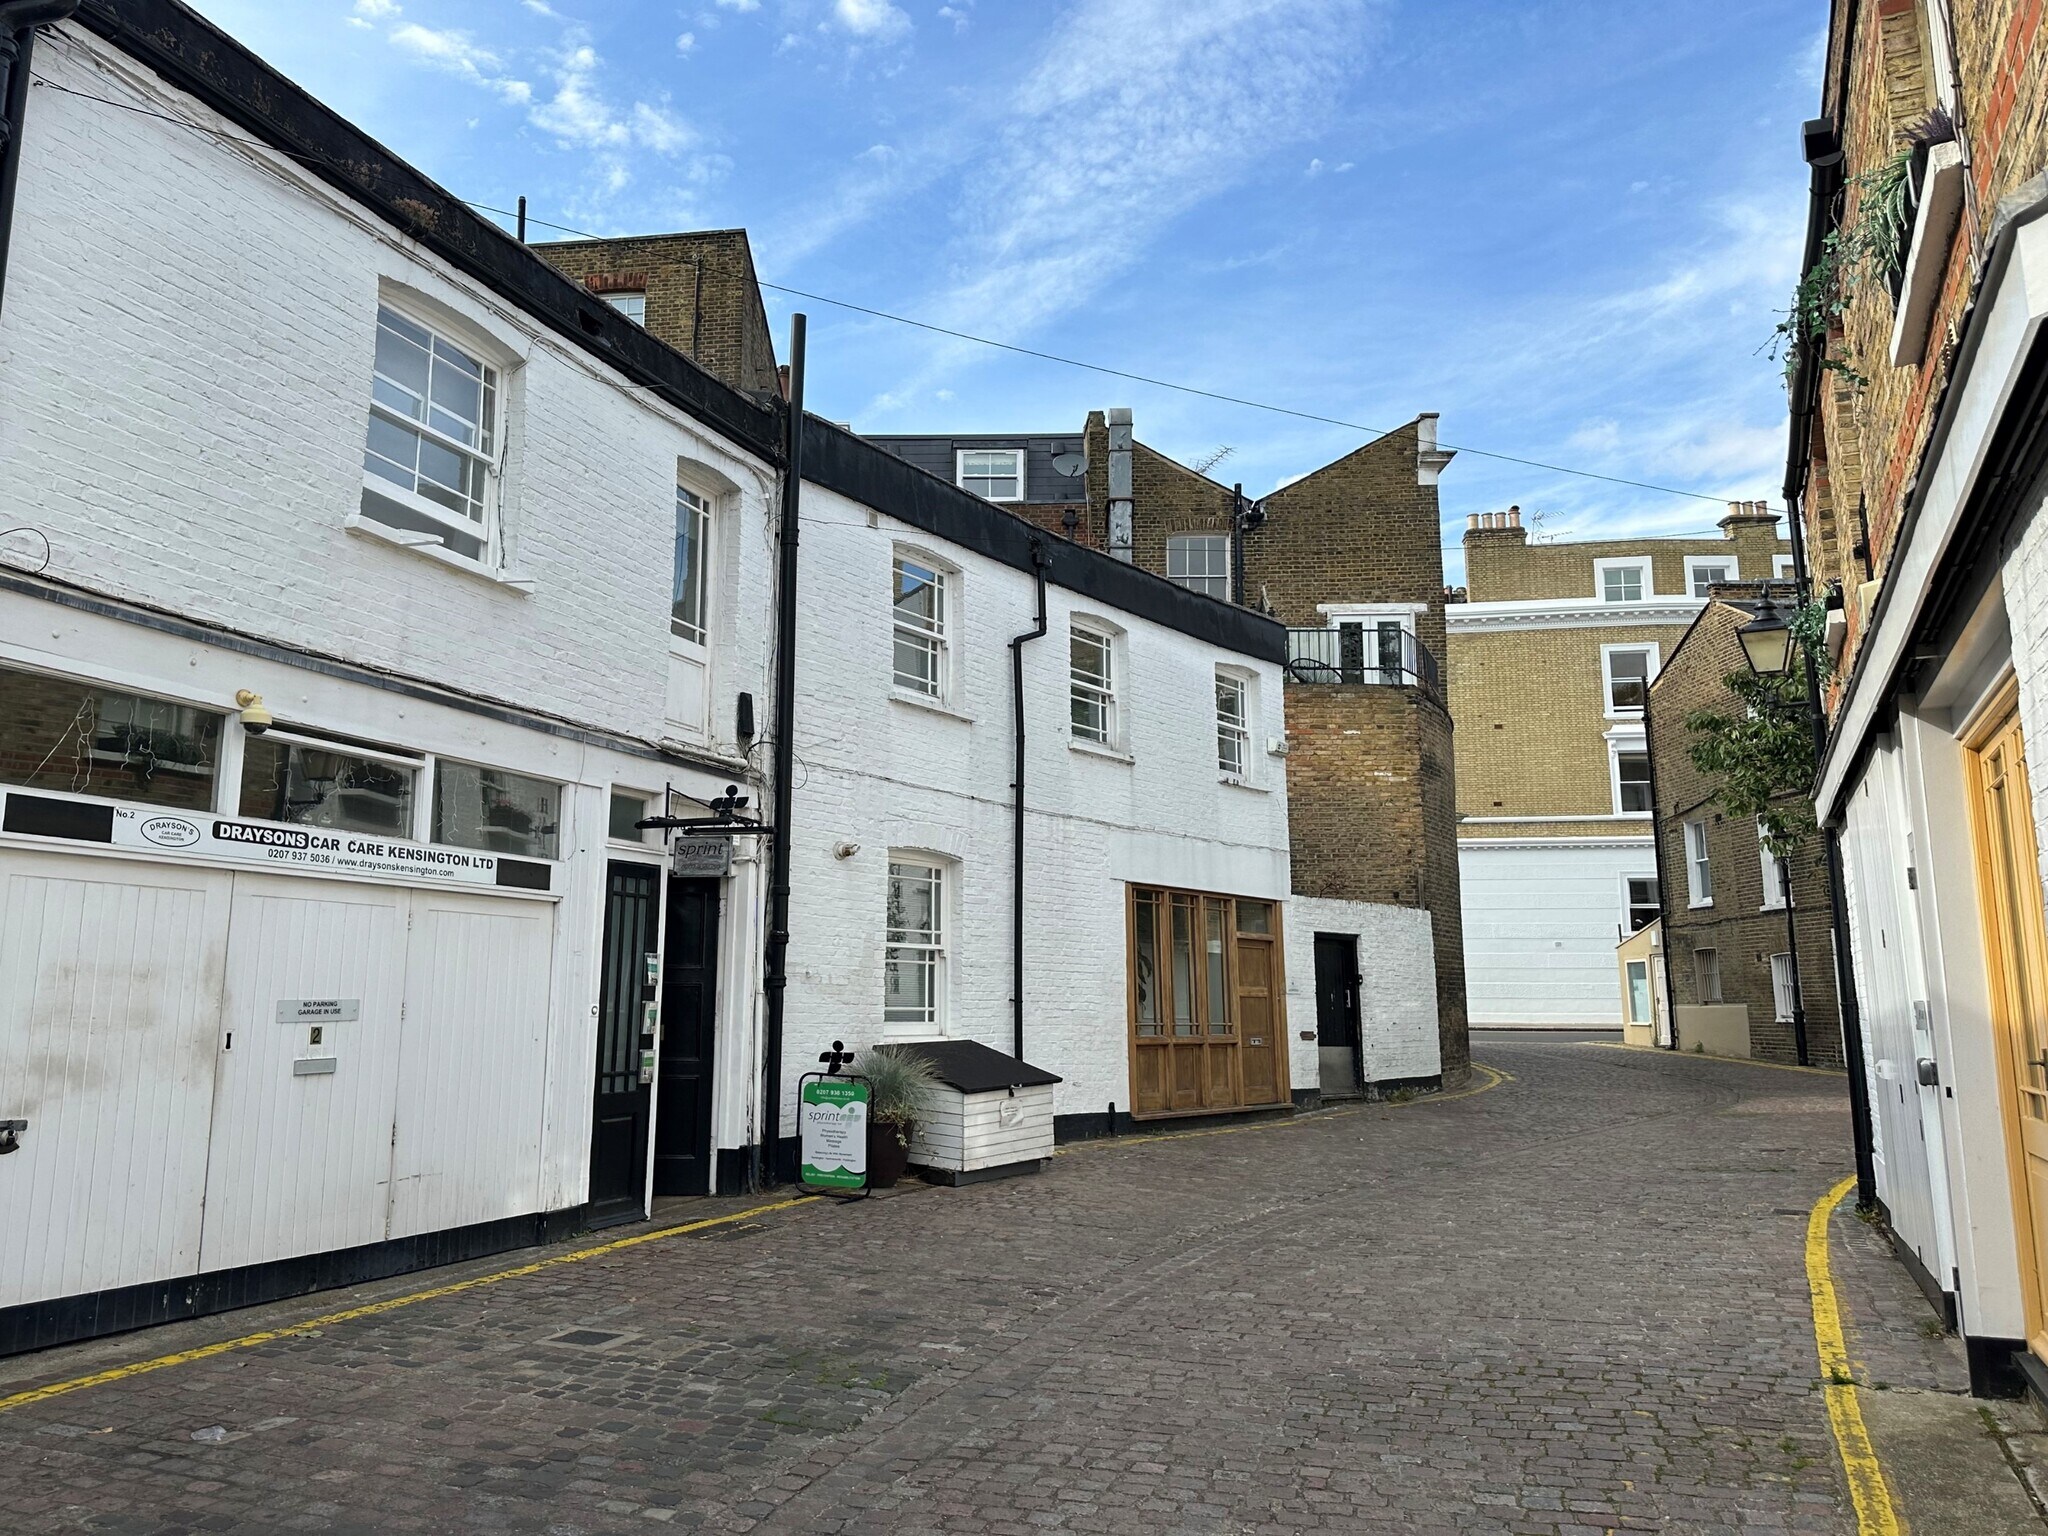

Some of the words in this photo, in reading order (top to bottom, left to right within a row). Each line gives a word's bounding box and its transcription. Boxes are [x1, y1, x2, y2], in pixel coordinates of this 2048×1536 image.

[116, 809, 135, 819] No.2
[149, 822, 195, 836] DRAYSON'S
[219, 823, 307, 848] DRAYSONS
[310, 836, 340, 851] CAR
[347, 840, 384, 857] CARE
[388, 846, 469, 868] KENSINGTON
[472, 857, 494, 870] LTD
[678, 841, 723, 858] sprint
[267, 848, 290, 859] 0207
[291, 851, 308, 861] 937
[310, 853, 330, 865] 5036
[337, 857, 454, 877] www.draysonskensington.com
[312, 1028, 320, 1043] 2
[809, 1111, 840, 1122] sprint
